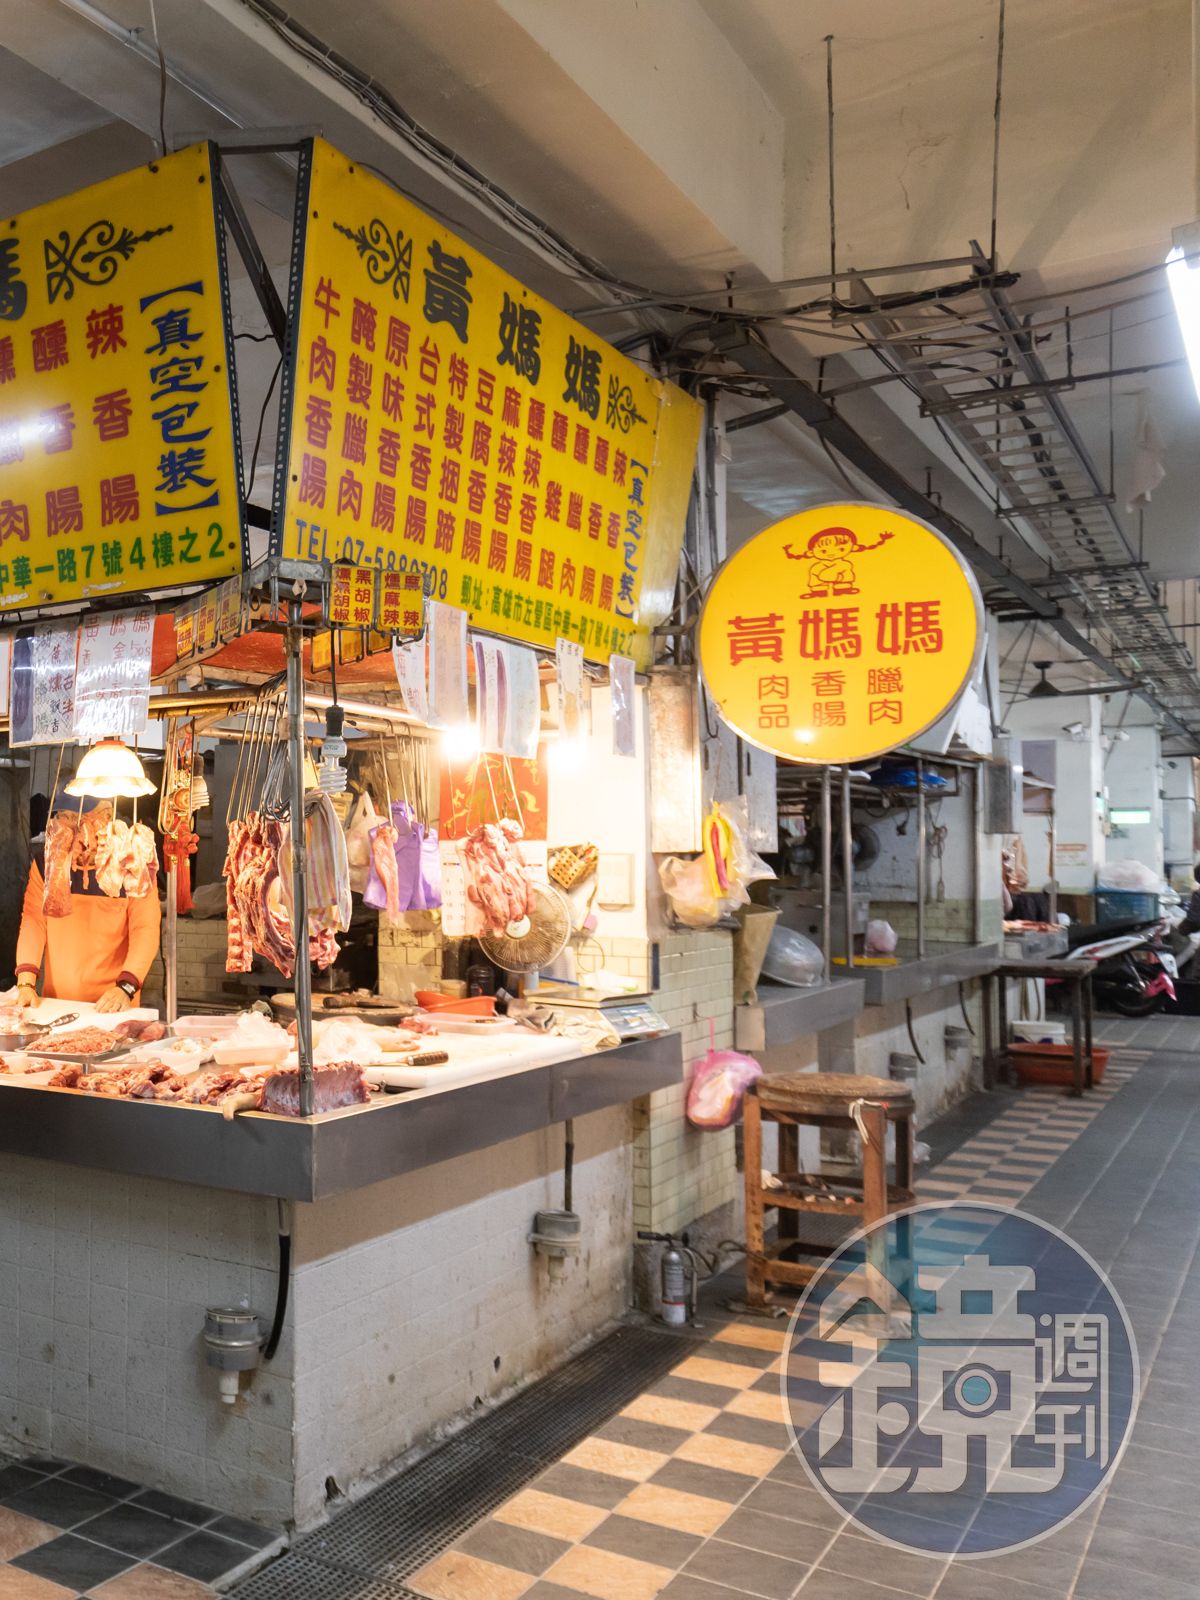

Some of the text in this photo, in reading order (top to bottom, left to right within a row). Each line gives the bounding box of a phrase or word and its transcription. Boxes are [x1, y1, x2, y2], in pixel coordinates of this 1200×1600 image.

[86, 303, 140, 528] 辣香腸
[299, 276, 341, 510] 牛肉香腸
[371, 315, 411, 534] 原味香腸
[423, 239, 603, 421] 黃媽媽
[403, 335, 441, 545] 台式香腸
[433, 352, 469, 554] 特製捆蹄
[461, 368, 496, 565] 豆腐香腸
[487, 385, 522, 574] 麻辣香腸
[598, 447, 628, 612] 辣香腸
[353, 569, 372, 622] 黑胡椒
[727, 601, 943, 666] 黃媽媽
[758, 674, 790, 729] 肉品
[811, 670, 846, 727] 香腸
